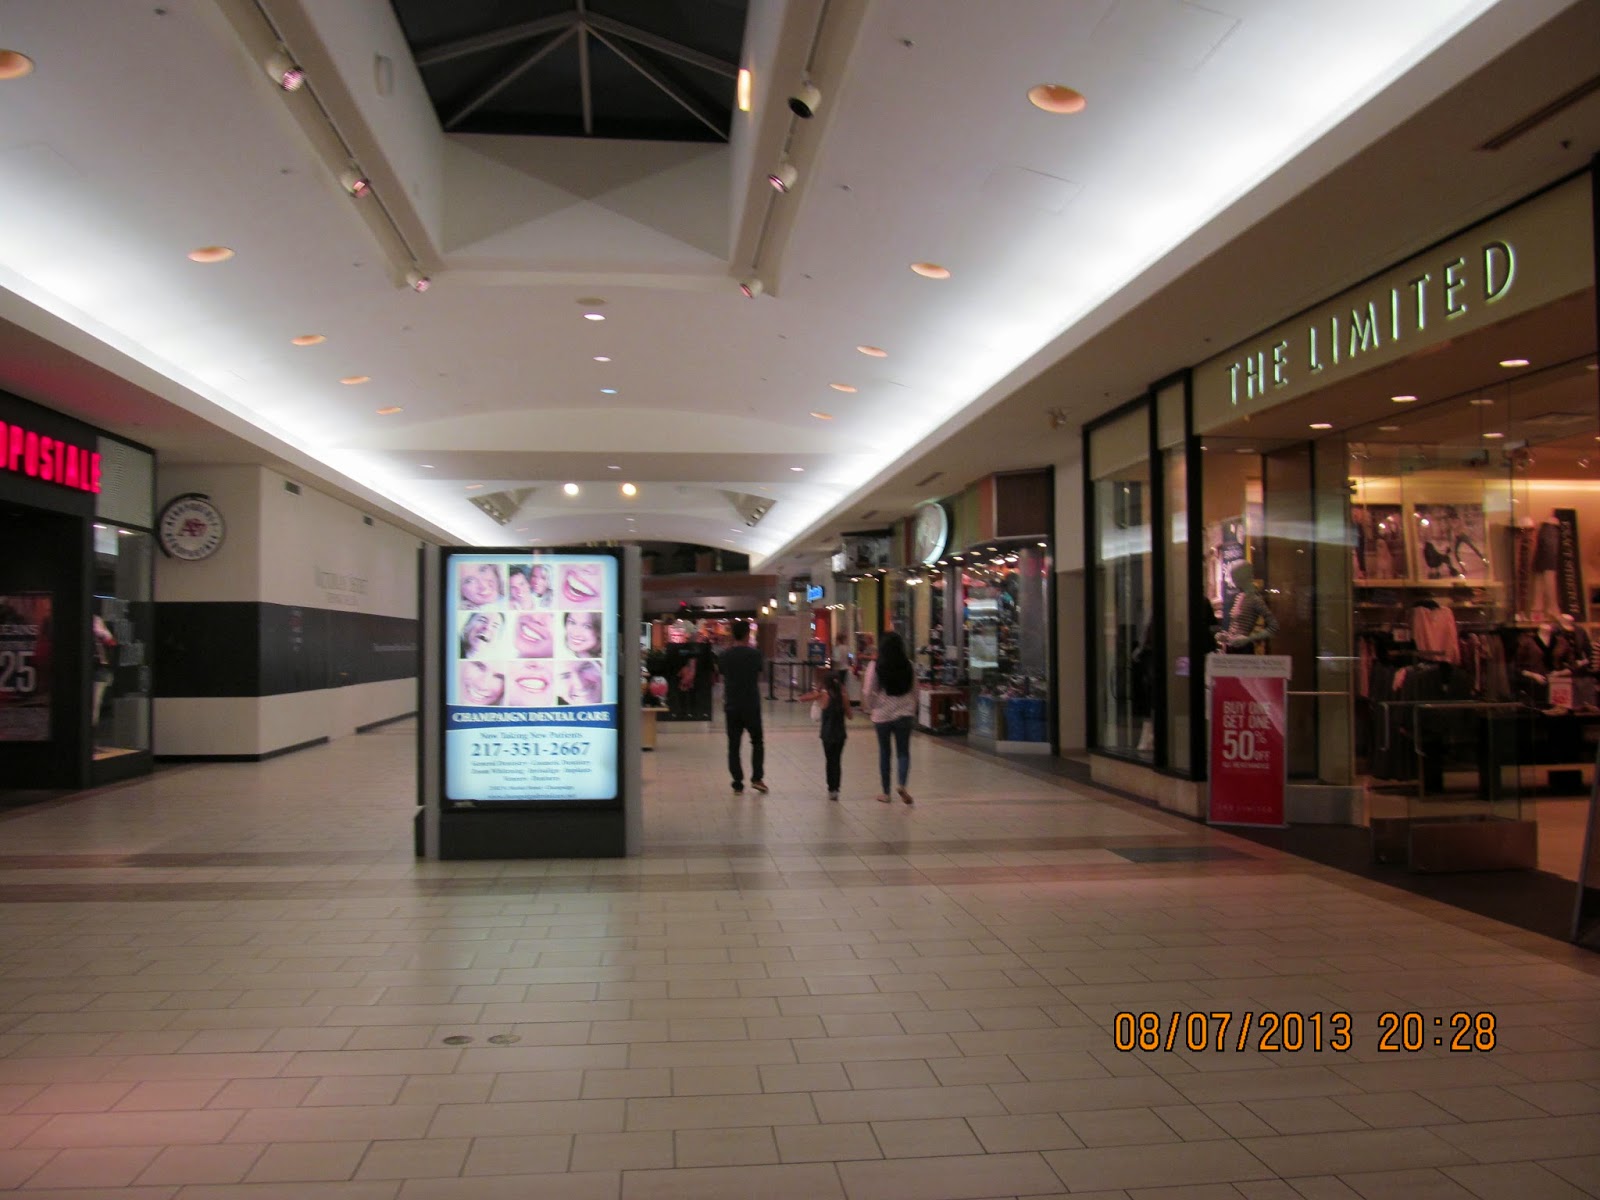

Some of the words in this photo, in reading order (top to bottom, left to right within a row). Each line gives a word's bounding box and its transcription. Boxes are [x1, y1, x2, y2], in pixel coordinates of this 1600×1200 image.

[1226, 340, 1289, 406] THE
[1308, 240, 1518, 373] LIMITED
[452, 712, 528, 722] CHAMPAIGN
[528, 711, 576, 722] DENTAL
[576, 711, 610, 721] CARE
[1223, 714, 1245, 729] GET
[1248, 715, 1272, 730] ONE
[472, 741, 590, 757] 217-351-2667
